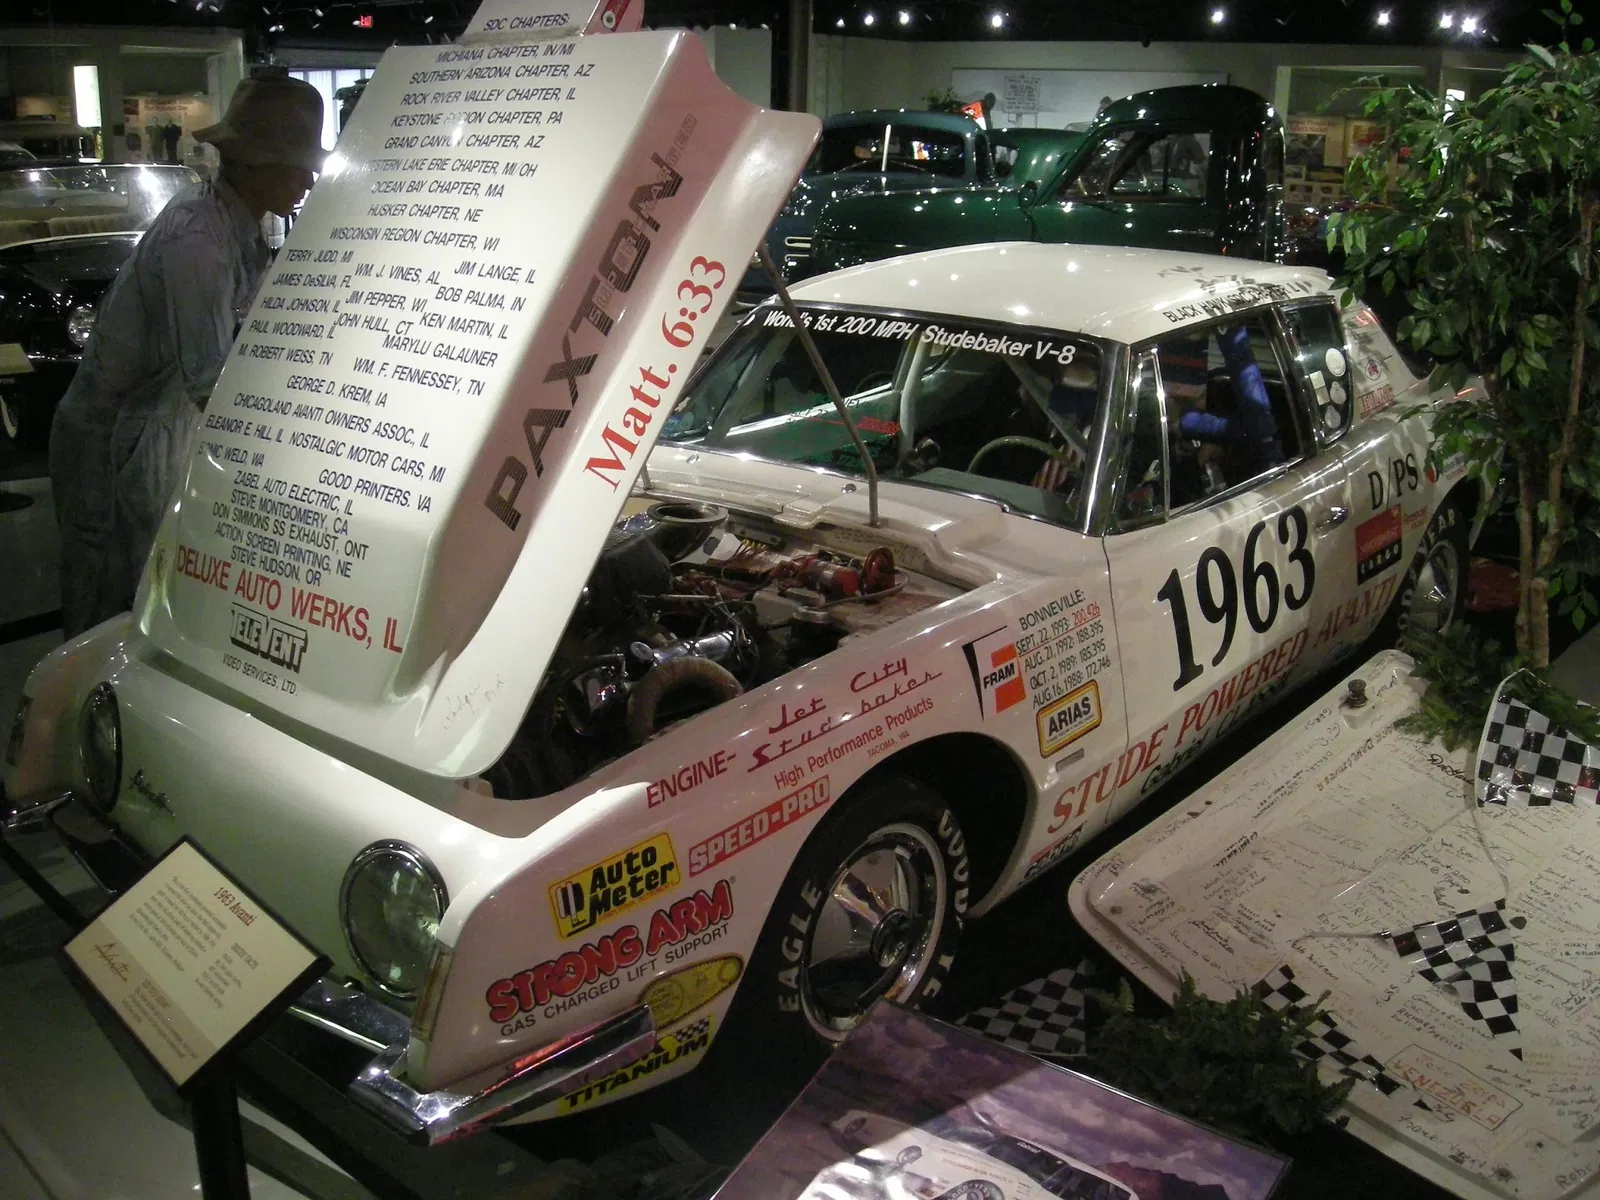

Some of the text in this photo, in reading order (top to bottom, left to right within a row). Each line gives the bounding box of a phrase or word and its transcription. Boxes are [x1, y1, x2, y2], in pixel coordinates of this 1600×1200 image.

[483, 14, 570, 31] SDC CHAPTERS:
[401, 87, 576, 105] ROCK RIVER VALLEY CHAPTER, IL
[410, 64, 595, 84] SOUTHERN ARIZONA CHAPTER, AZ
[367, 203, 484, 222] HUSKER CHAPTER, NE
[330, 227, 500, 252] WISCONSIN REGION CHAPTER, WI
[354, 263, 441, 285] WM. J. VINES, AL
[454, 261, 537, 284] JIM LANGE, IL
[345, 290, 428, 313] JIM PEPPER, WI
[435, 286, 526, 312] BOB PALMA, IN
[1163, 304, 1202, 323] BLACK
[334, 313, 413, 335] JOHN HULL, CT
[420, 312, 509, 339] KEN MARTIN, IL
[484, 151, 684, 532] PAXTON
[813, 314, 838, 331] 1st
[835, 316, 873, 335] 200
[873, 319, 920, 341] MPH
[921, 325, 1032, 358] Studebaker
[1033, 340, 1076, 366] V-8
[382, 334, 498, 368] MARYLU GALAUNER
[287, 375, 389, 408] GEORGE D. KREM, IA
[353, 357, 486, 397] WM. F. FENNESSEY, TN
[583, 255, 727, 493] Matt. 6:33
[233, 392, 292, 415] CHICAGOLAND
[293, 403, 324, 423] AVANTI
[324, 409, 372, 434] OWNERS
[419, 432, 431, 449] IL
[288, 432, 447, 483] NOSTALGIC MOTOR CARS, MI
[230, 489, 349, 536] STEVE MONTGOMERY, CA
[233, 470, 354, 516] ZABEL AUTO ELECTRIC, IL
[319, 469, 350, 490] GOOD
[416, 495, 432, 513] VA
[212, 502, 370, 560] DON SIMMONS SS EXHAUST, ONT
[215, 523, 353, 578] ACTION SCREEN PRINTING, NE
[231, 545, 322, 587] STEVE HUDSON, OR
[176, 545, 403, 654] DELUXE AUTO WERKS, IL
[1019, 588, 1086, 631] BONNEVILLE:
[1157, 503, 1315, 692] 1963
[1015, 635, 1039, 656] SEPT.
[1072, 601, 1100, 626] 200.426
[1024, 654, 1045, 673] AUG.
[1076, 620, 1104, 643] 188.395
[1079, 639, 1106, 663] 185.395
[222, 653, 241, 671] VIDEO
[281, 678, 299, 696] LTD.
[768, 657, 908, 734] Jet City
[983, 662, 1016, 690] FRAM
[1032, 689, 1052, 710] AUG.
[1047, 724, 1168, 835] STUDE
[1173, 628, 1308, 749] POWERED
[1313, 573, 1398, 648] AVANTI
[1048, 696, 1091, 738] ARIAS
[774, 696, 934, 791] High Performance Products
[646, 750, 737, 808] ENGINE-
[690, 777, 829, 876] SPEED-PRO
[587, 861, 675, 920] Meter
[590, 846, 657, 893] Auto
[213, 886, 257, 927] 1963 Avanti
[486, 925, 644, 1023] STRONG
[646, 879, 734, 956] ARM
[778, 879, 823, 1012] EAGLE
[500, 1015, 537, 1038] GAS
[543, 976, 621, 1020] CHARGED
[627, 958, 658, 983] LIFT
[665, 922, 730, 965] SUPPORT
